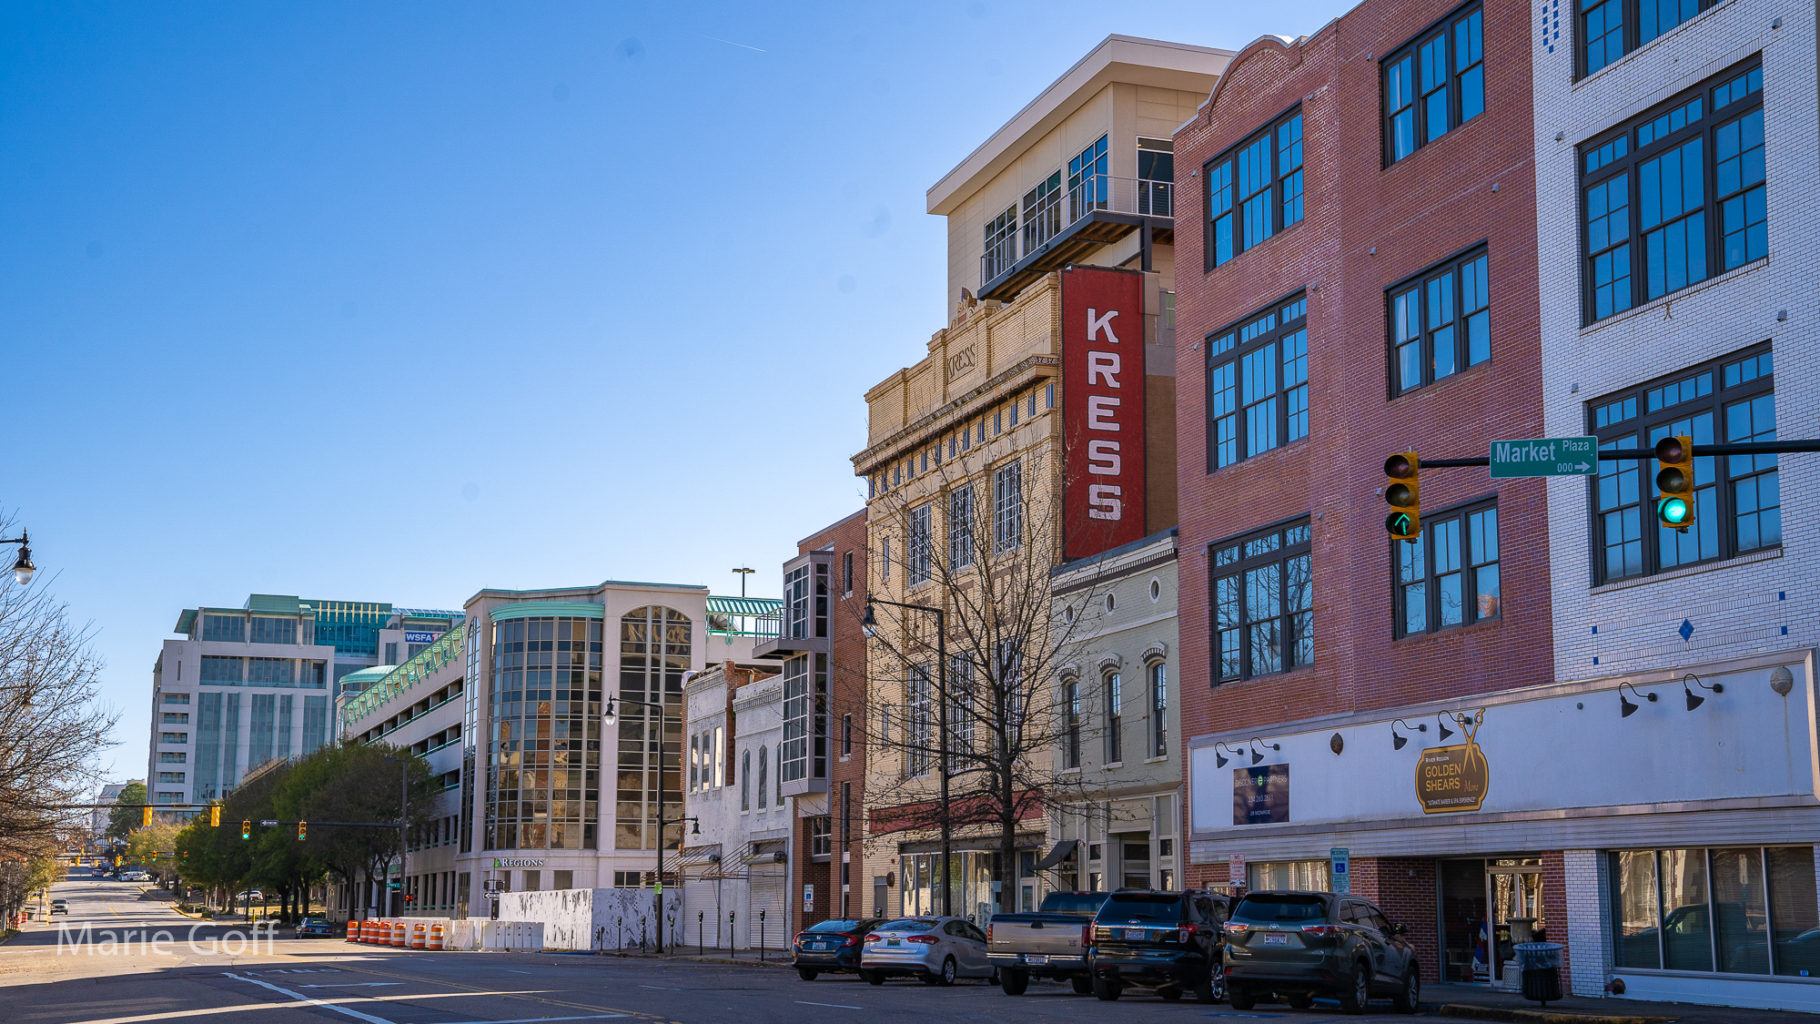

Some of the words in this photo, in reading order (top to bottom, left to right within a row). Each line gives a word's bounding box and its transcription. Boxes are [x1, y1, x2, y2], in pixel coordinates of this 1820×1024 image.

[946, 342, 976, 379] KRESS
[1087, 308, 1121, 520] KRESS
[1496, 442, 1556, 463] Market
[1562, 440, 1589, 452] Plaza
[1557, 463, 1573, 472] 000
[406, 633, 432, 642] WSFA
[1426, 763, 1461, 777] GOLDEN
[1426, 778, 1460, 791] SHEARS
[502, 858, 544, 868] REGIONS
